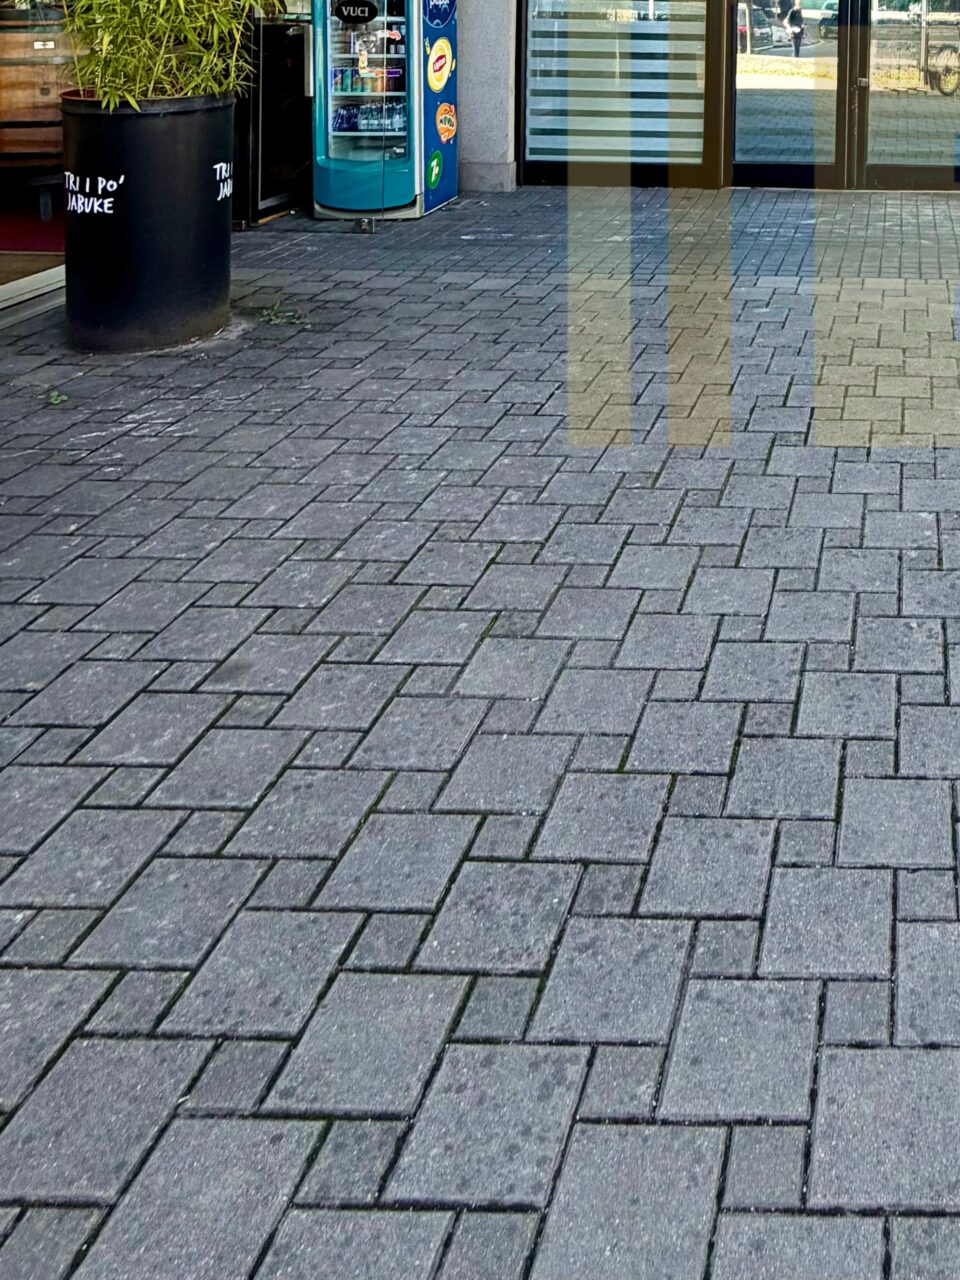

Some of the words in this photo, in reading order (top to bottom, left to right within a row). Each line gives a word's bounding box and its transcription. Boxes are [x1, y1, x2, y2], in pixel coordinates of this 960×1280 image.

[341, 7, 369, 17] VUCI
[64, 172, 80, 191] TRI
[86, 177, 90, 192] I
[67, 192, 114, 214] JABUKE
